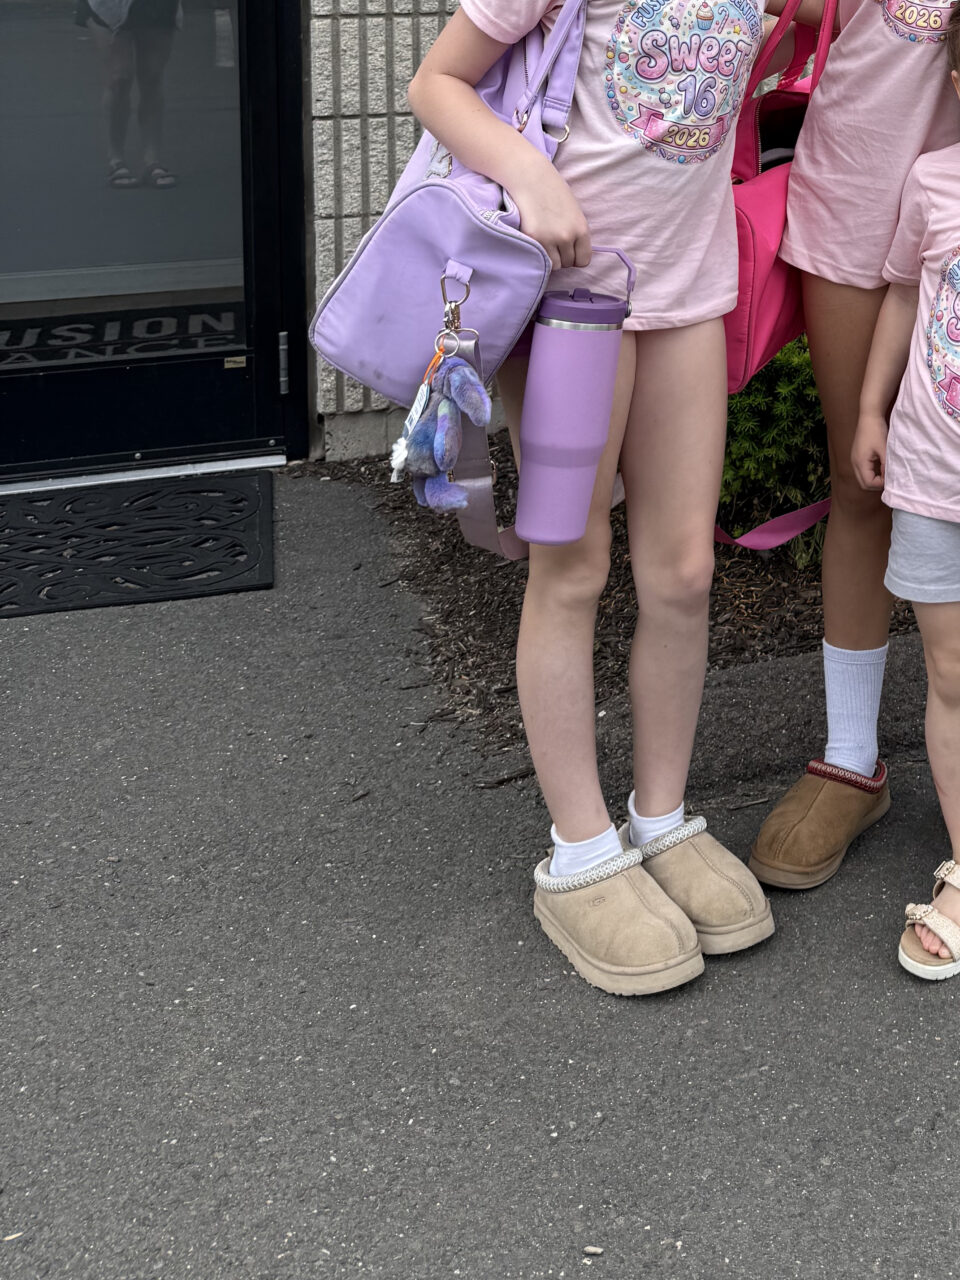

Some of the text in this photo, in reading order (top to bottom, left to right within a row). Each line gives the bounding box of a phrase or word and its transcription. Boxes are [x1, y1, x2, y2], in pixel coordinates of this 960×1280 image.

[895, 1, 942, 29] 2026
[677, 74, 717, 117] 16
[662, 125, 711, 147] 2026
[0, 312, 235, 350] USION
[0, 335, 235, 365] ANCE
